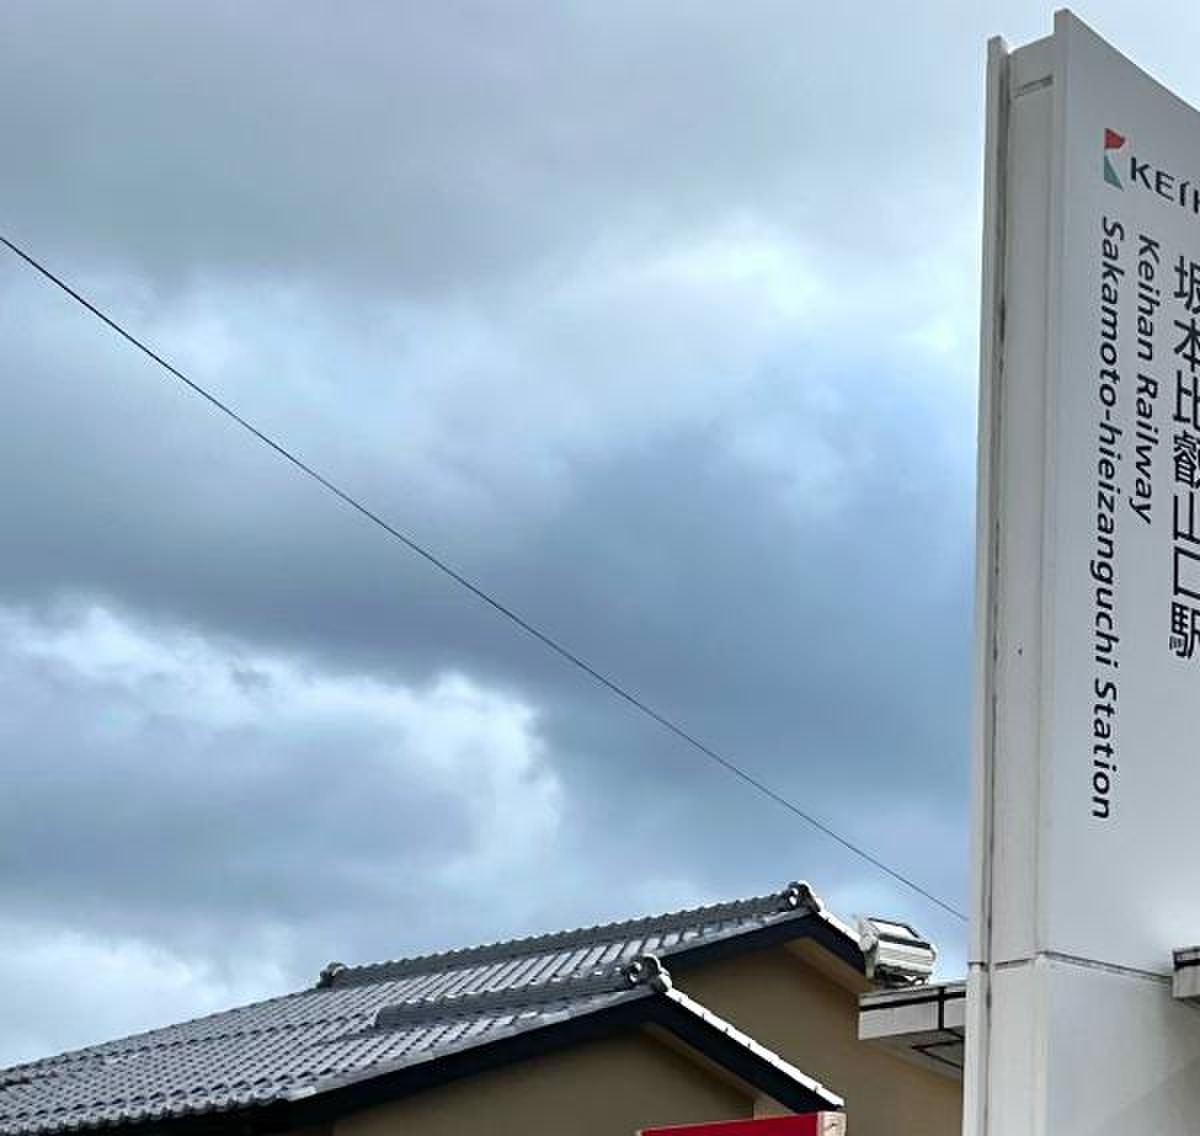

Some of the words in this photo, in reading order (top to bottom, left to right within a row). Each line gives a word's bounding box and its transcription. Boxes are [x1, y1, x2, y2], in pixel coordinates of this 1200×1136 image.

[1137, 233, 1161, 362] Keihan
[1089, 215, 1126, 669] Sakamoto-hieizanguchi
[1128, 372, 1159, 525] Railway
[1091, 677, 1118, 820] Station
